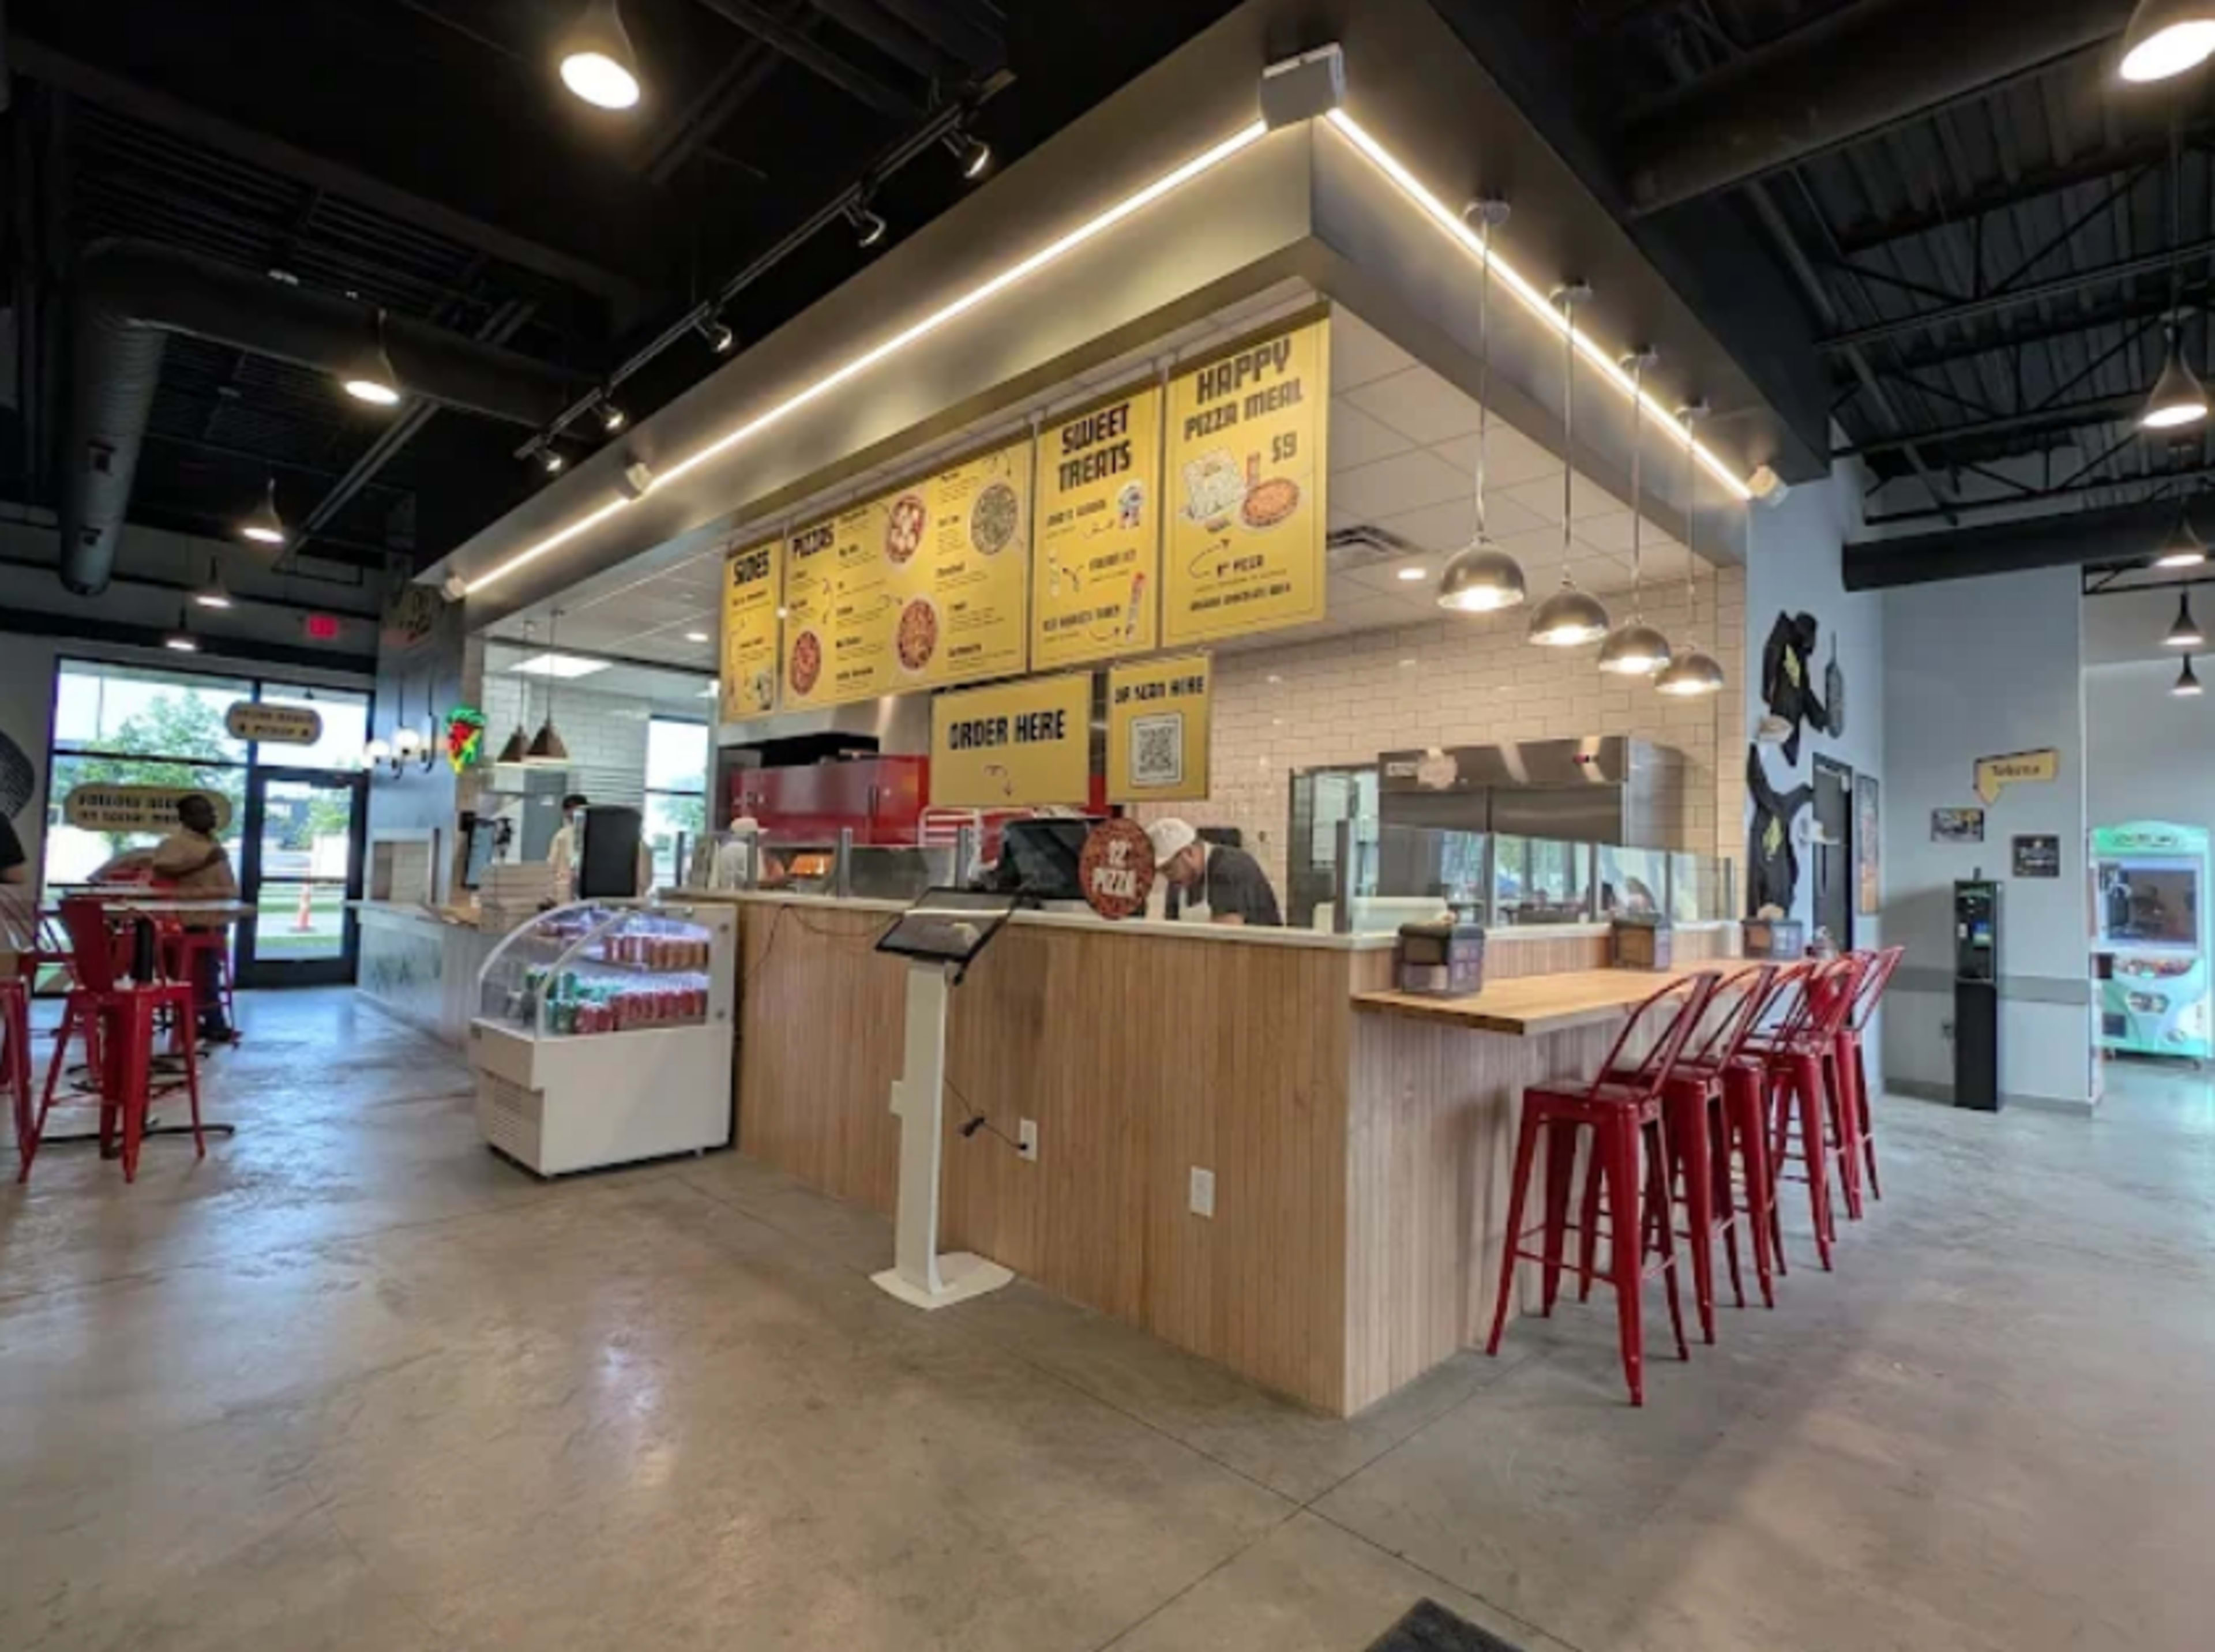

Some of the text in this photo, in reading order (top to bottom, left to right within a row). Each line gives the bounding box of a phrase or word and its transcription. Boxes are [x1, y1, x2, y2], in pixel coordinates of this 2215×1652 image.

[1196, 338, 1292, 405] HAPPY
[1062, 404, 1130, 455] SWEET
[1184, 378, 1302, 442] PIZZA MEAL
[1058, 440, 1131, 493] TREATS
[1271, 431, 1298, 463] $9
[734, 550, 769, 587] SIDES
[1135, 682, 1166, 700] SCAN
[1170, 675, 1203, 696] HERE
[949, 709, 1065, 750] ORDER HERE
[1092, 868, 1137, 899] PIZZA
